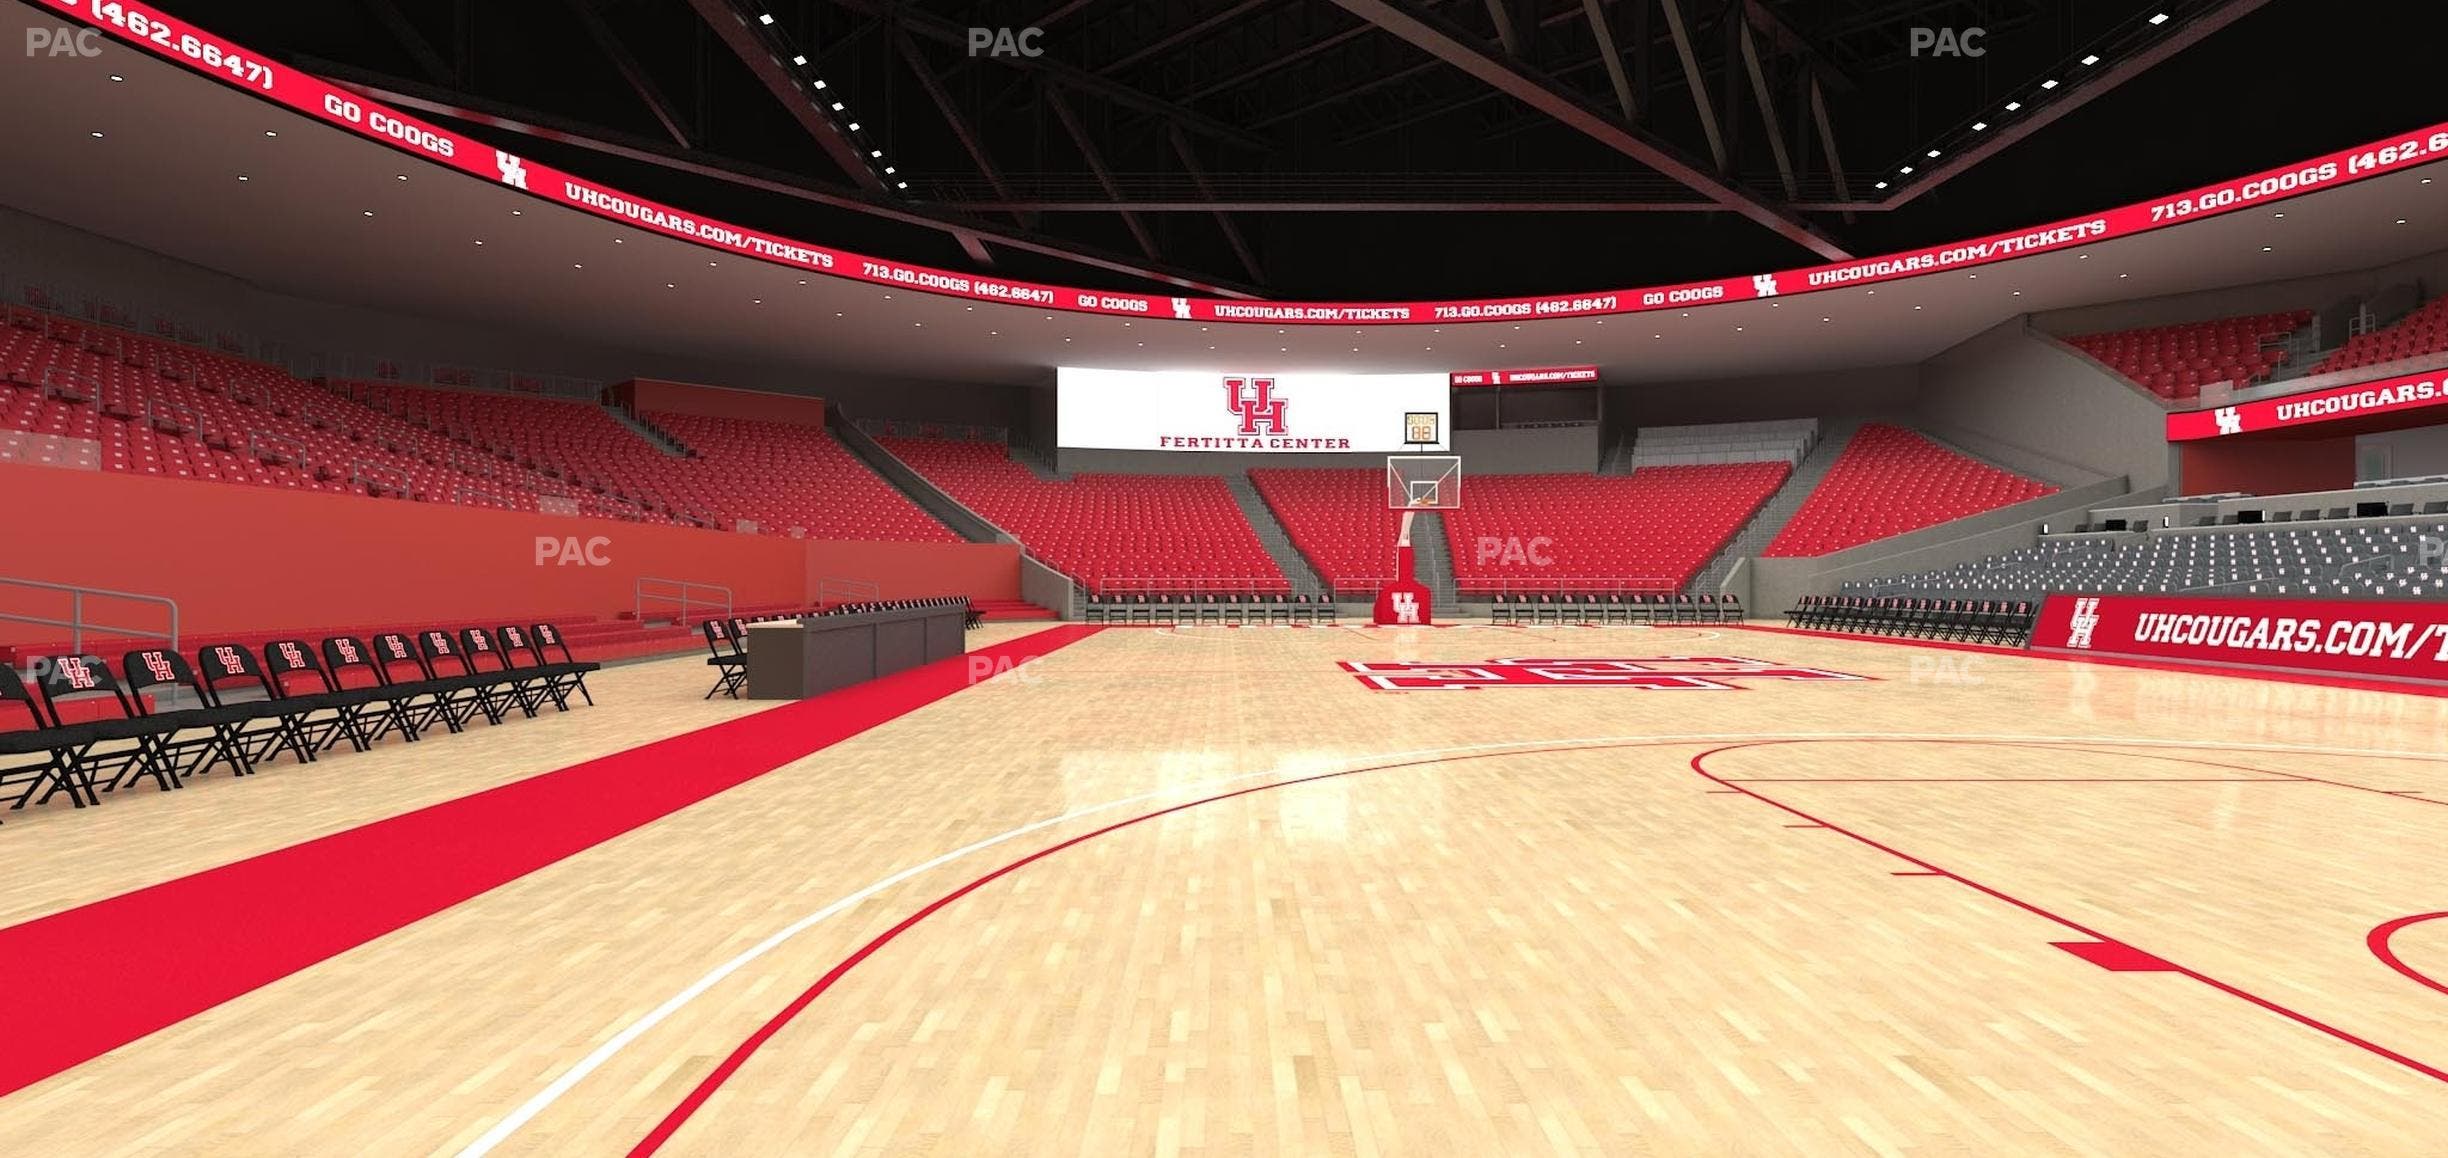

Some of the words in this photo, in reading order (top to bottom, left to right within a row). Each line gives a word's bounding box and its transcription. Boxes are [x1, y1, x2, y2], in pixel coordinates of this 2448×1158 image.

[325, 94, 360, 122] GO
[370, 112, 453, 156] COOGS
[2152, 163, 2337, 221] 713.GO.COOGS
[566, 182, 833, 268] UHCOUGARS.COM/TICKETS
[1809, 220, 2105, 285] UHCOUGARS.COM/TICKETS
[864, 263, 969, 291] 713.GO.COOGS
[1078, 295, 1097, 307] GO
[1102, 297, 1147, 311] COOGS
[1644, 292, 1664, 304] GO
[1669, 286, 1723, 302] COOGS
[1215, 306, 1409, 319] UHCOUGARS.COM/TICKETS
[1435, 304, 1531, 317] 713.GO.COOGS
[1223, 377, 1288, 435] UH
[2277, 380, 2448, 421] UHCOUGARS.
[1160, 437, 1264, 448] FERTITTA
[1270, 439, 1350, 449] CENTER
[2066, 598, 2099, 649] UH
[215, 647, 244, 674] UH
[279, 643, 305, 668] UH
[335, 639, 359, 662] UH
[385, 635, 406, 658] UH
[57, 658, 95, 688] UH
[142, 652, 174, 681] UH
